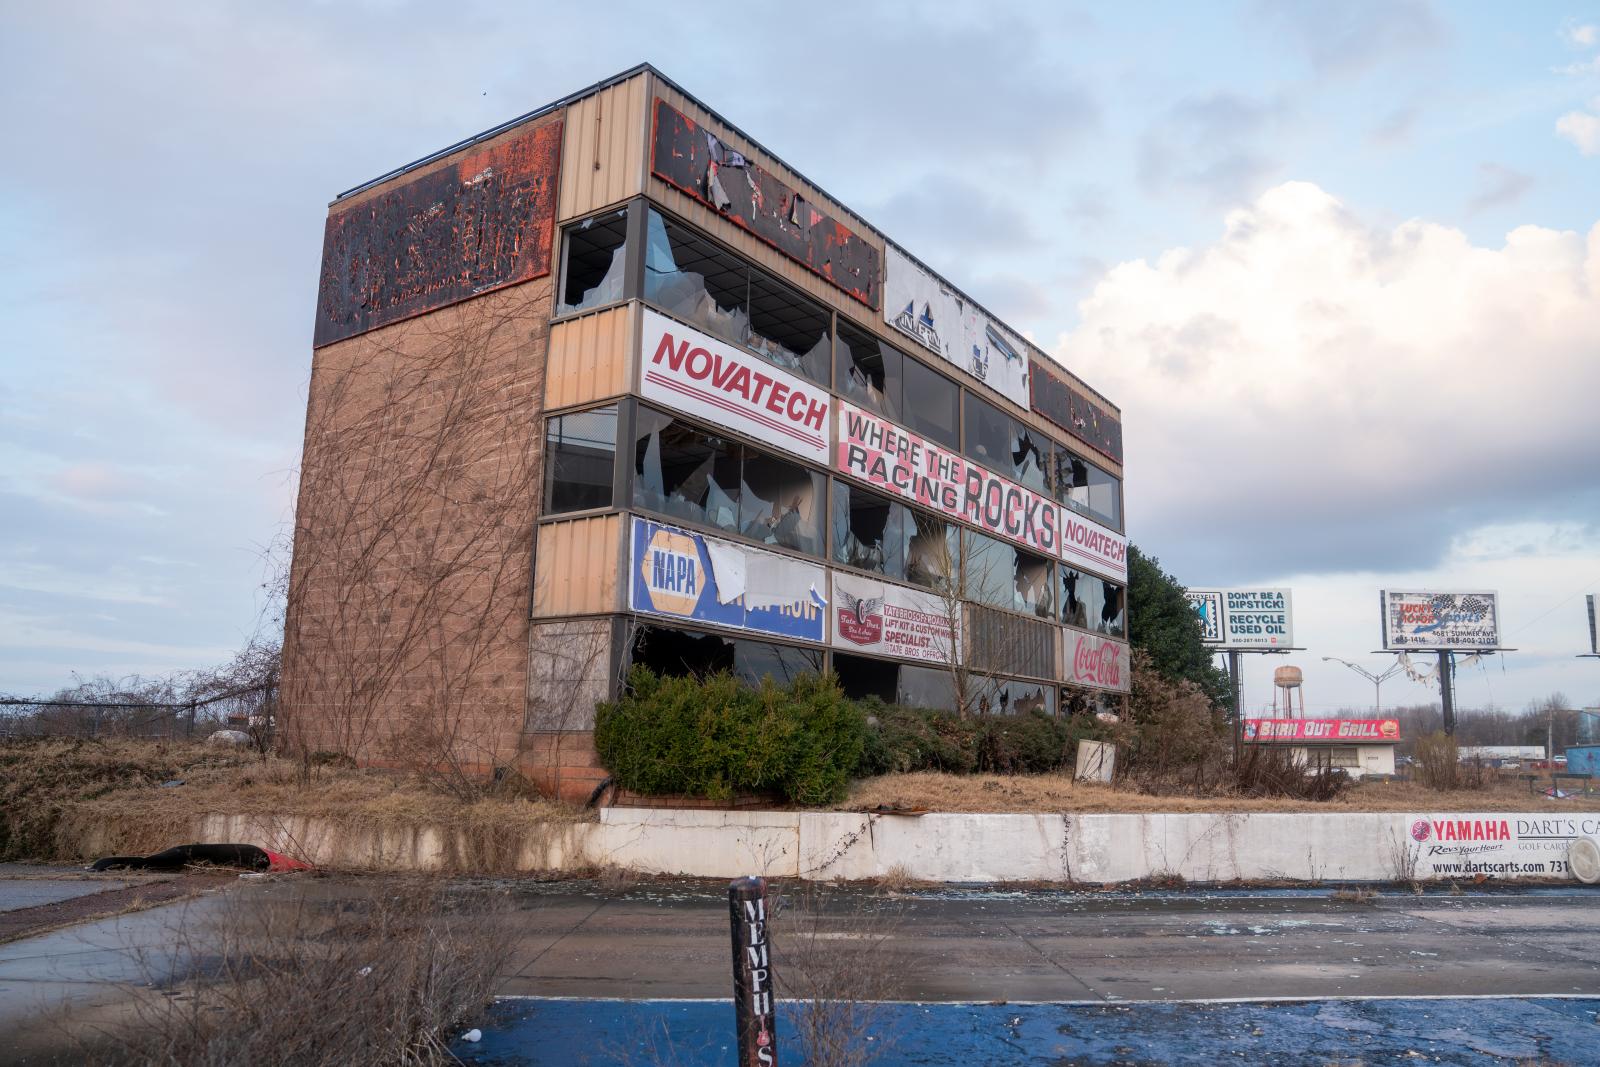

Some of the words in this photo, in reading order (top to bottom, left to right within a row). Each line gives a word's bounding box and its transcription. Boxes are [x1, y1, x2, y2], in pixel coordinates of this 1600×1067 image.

[652, 332, 828, 431] NOVATECH
[849, 415, 921, 466] WHERE
[928, 450, 960, 484] THE
[847, 445, 958, 510] RACING
[963, 466, 1055, 549] ROCKS
[1065, 519, 1126, 563] NOVATECH
[653, 550, 696, 595] NAPA
[1227, 592, 1257, 600] DON'T
[1260, 592, 1274, 600] BE
[1276, 592, 1284, 600] A
[1228, 600, 1285, 609] DIPSTICK!
[1400, 603, 1433, 614] LUCKY
[1229, 615, 1285, 624] RECYCLE
[885, 618, 898, 628] LIFT
[898, 620, 910, 631] KIT
[916, 624, 940, 637] CUSTOM
[1230, 625, 1262, 634] USED
[1265, 625, 1286, 634] OIL
[885, 631, 931, 648] SPECIALIST
[1260, 721, 1299, 736] BURN
[1304, 721, 1334, 736] OUT
[1338, 721, 1379, 736] GRILL
[1433, 820, 1511, 841] YAMAHA
[1517, 819, 1576, 835] DART'S
[1428, 845, 1459, 857] Revs
[1459, 845, 1480, 855] Your
[1480, 844, 1503, 852] Heart
[1519, 842, 1541, 851] GOLF
[1433, 860, 1545, 874] www.dartscarts.com
